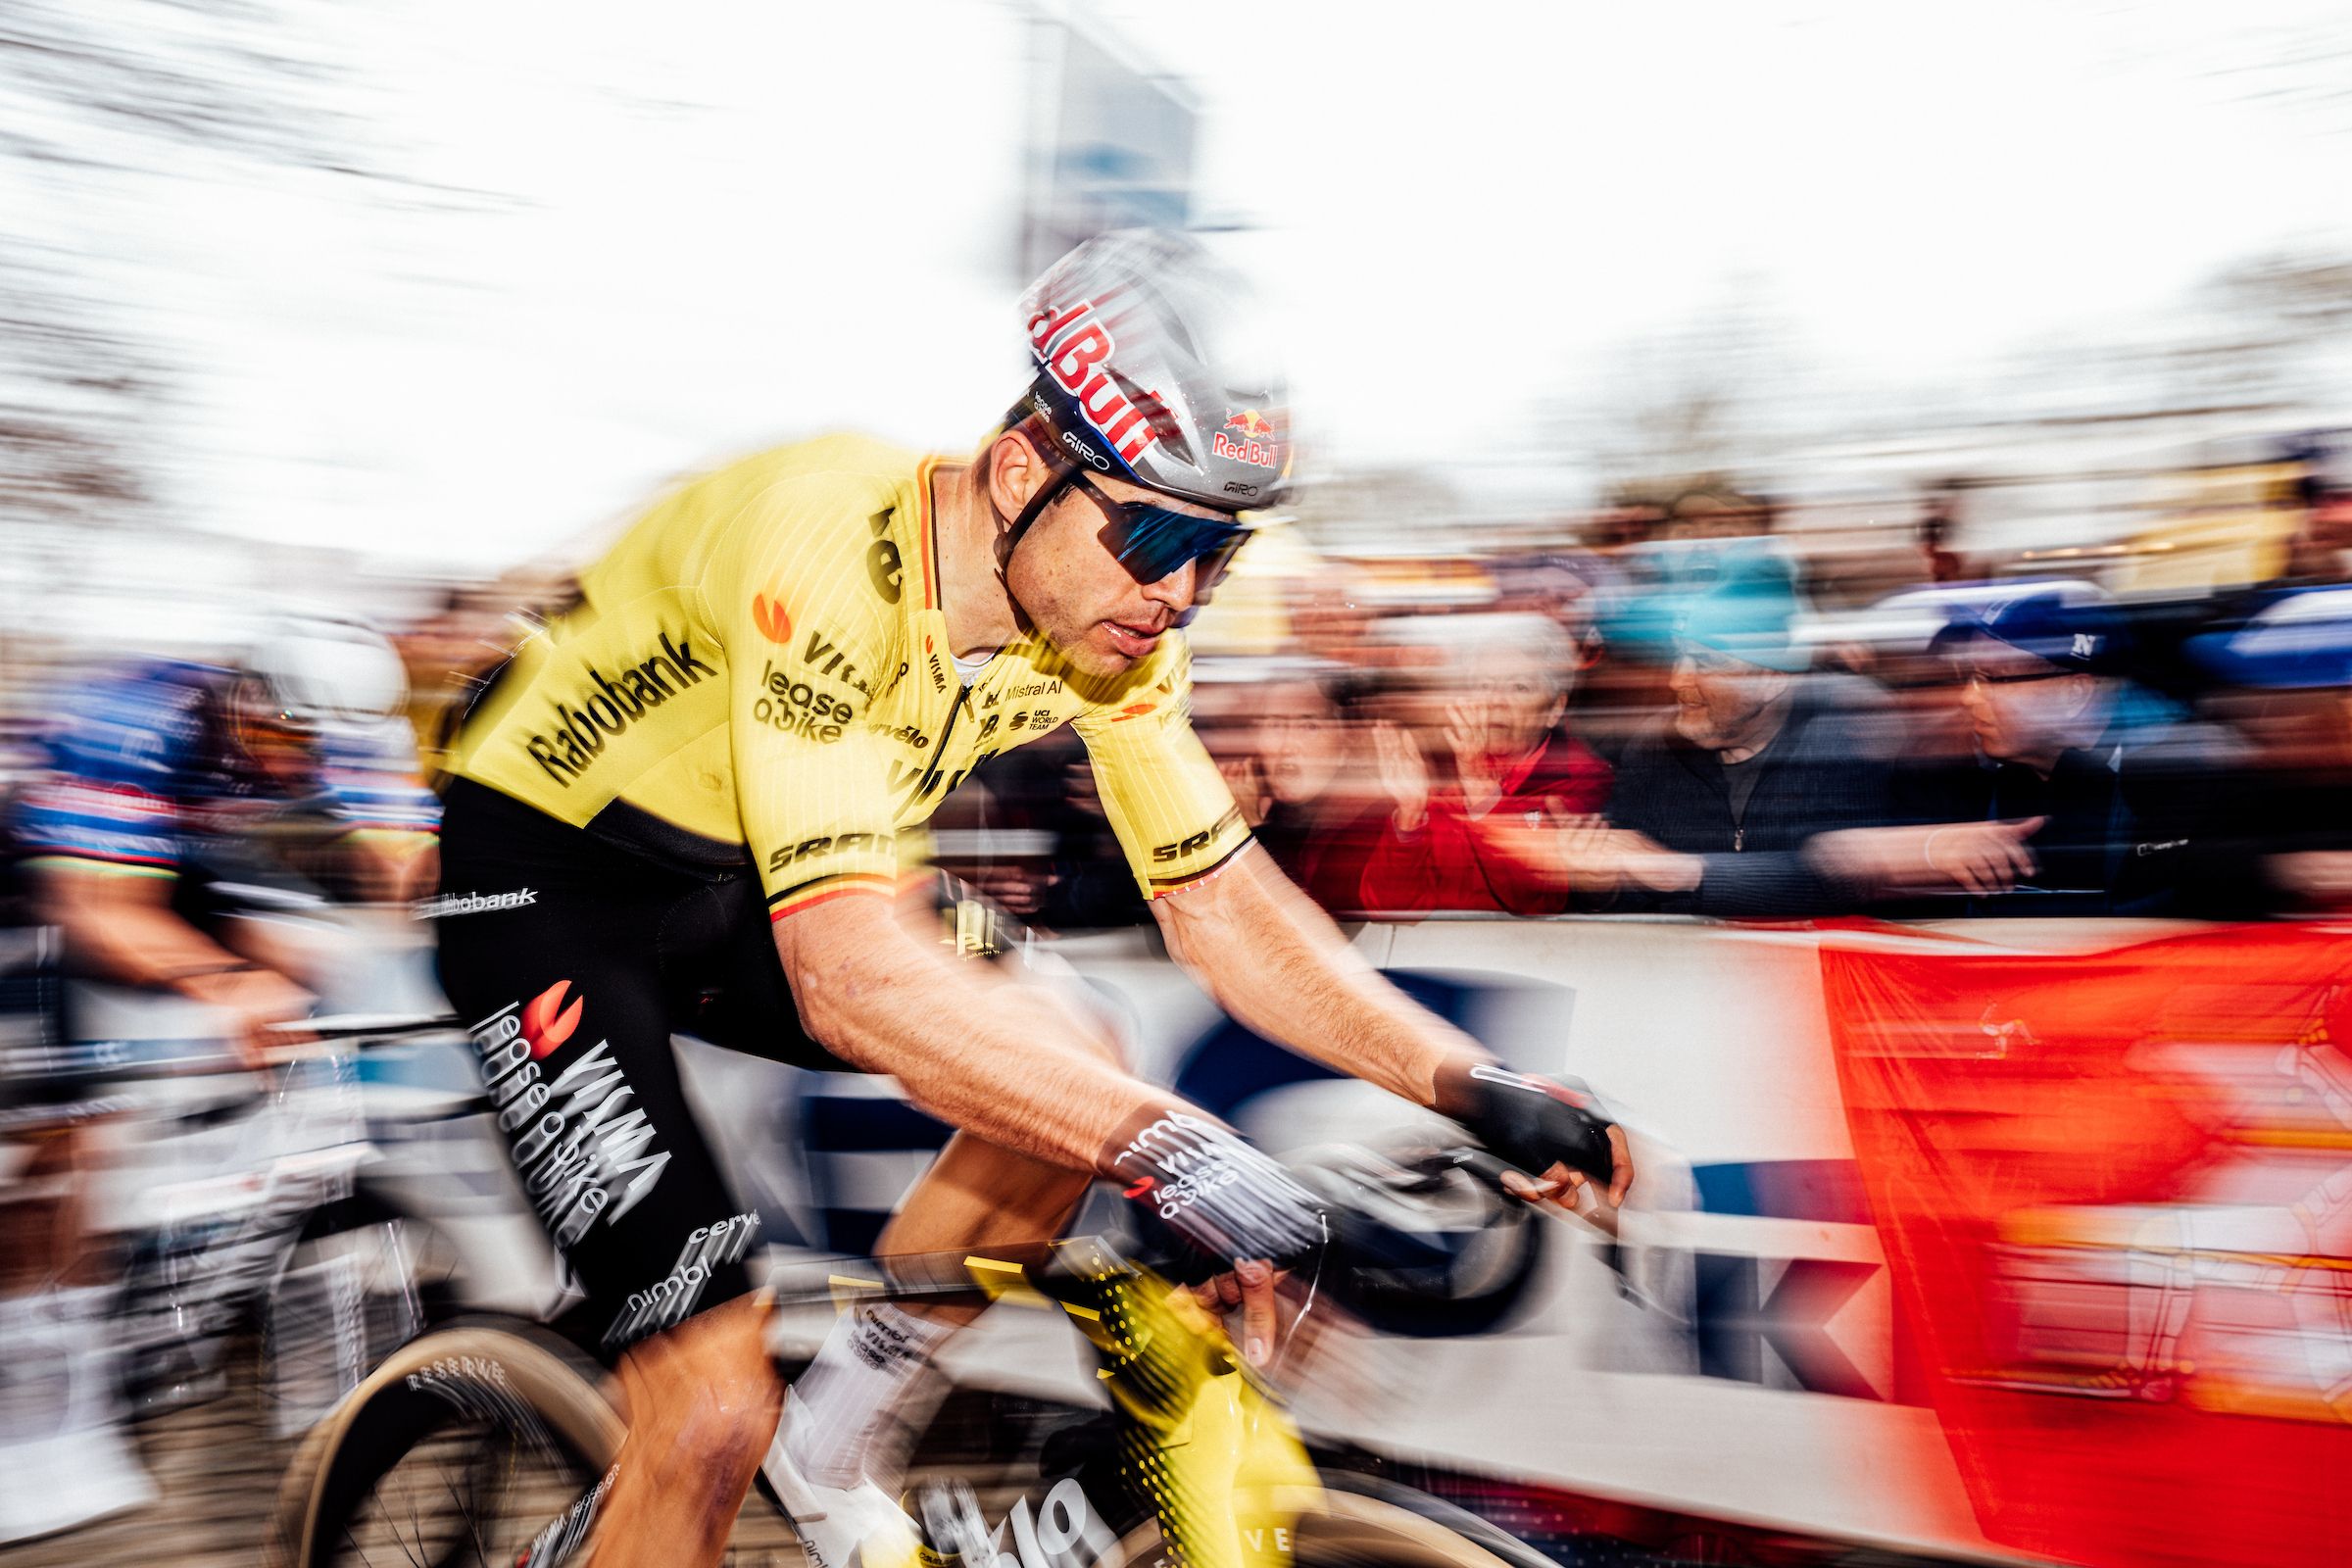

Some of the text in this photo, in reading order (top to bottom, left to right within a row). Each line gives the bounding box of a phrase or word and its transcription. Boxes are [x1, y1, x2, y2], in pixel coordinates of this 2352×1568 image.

[1062, 431, 1110, 470] GIRO
[1212, 431, 1278, 468] Red Bull
[1224, 481, 1258, 497] GIRO
[760, 660, 854, 725] lease
[929, 654, 947, 695] VISMA
[1005, 681, 1046, 702] Mistral
[1047, 680, 1063, 695] AI
[526, 632, 719, 789] Rabobank
[467, 1001, 552, 1111] lease
[563, 1039, 673, 1192] VISMA
[627, 1256, 713, 1312] nimbl
[406, 1356, 506, 1393] RESERVE
